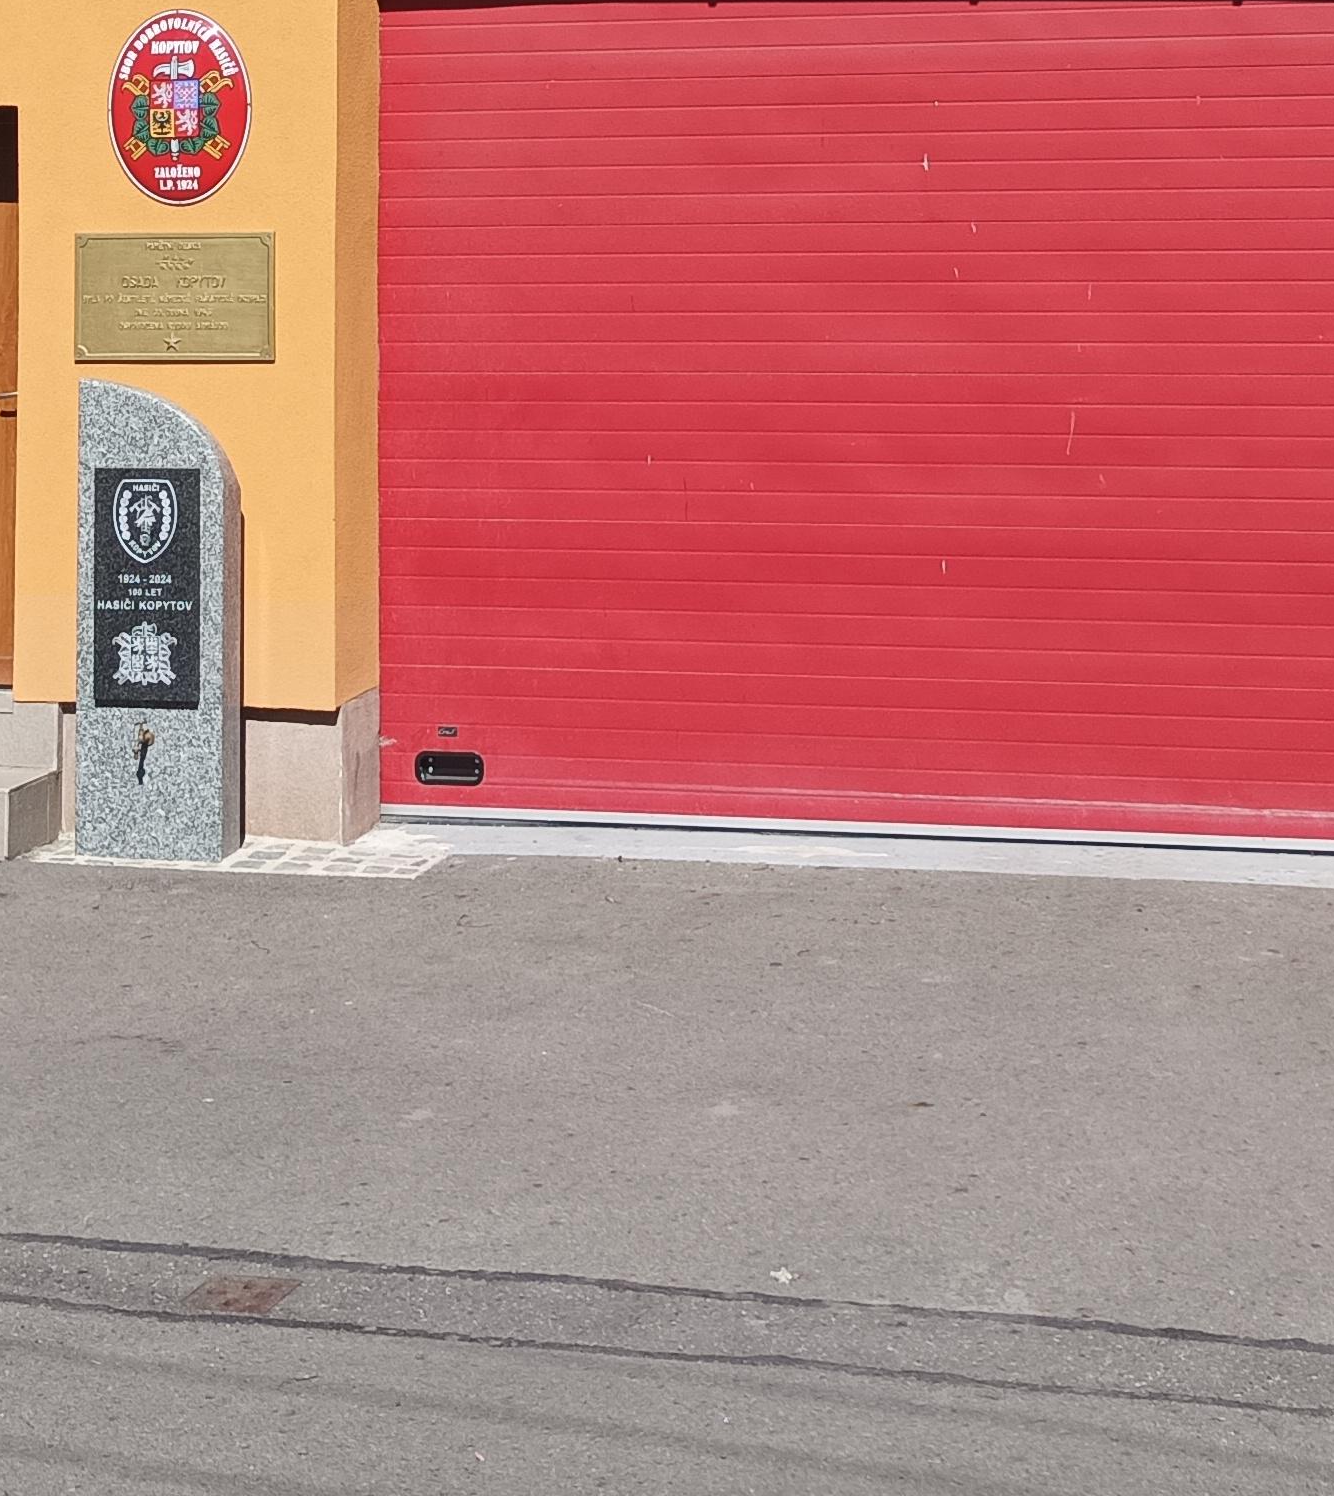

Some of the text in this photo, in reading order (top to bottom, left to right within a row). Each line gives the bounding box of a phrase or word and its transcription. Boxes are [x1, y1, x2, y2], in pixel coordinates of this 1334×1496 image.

[151, 40, 200, 55] KOPYTOV
[154, 164, 201, 179] ZALOŽENO
[177, 180, 198, 190] 1924
[122, 275, 227, 289] OSADA KOPYTOV
[133, 483, 160, 492] HASIČI
[128, 539, 162, 557] KOPYTOV
[117, 574, 140, 584] 1924
[149, 574, 172, 584] 2024
[128, 588, 162, 596] 100 LET
[97, 598, 193, 611] HASIČI KOPYTOV
